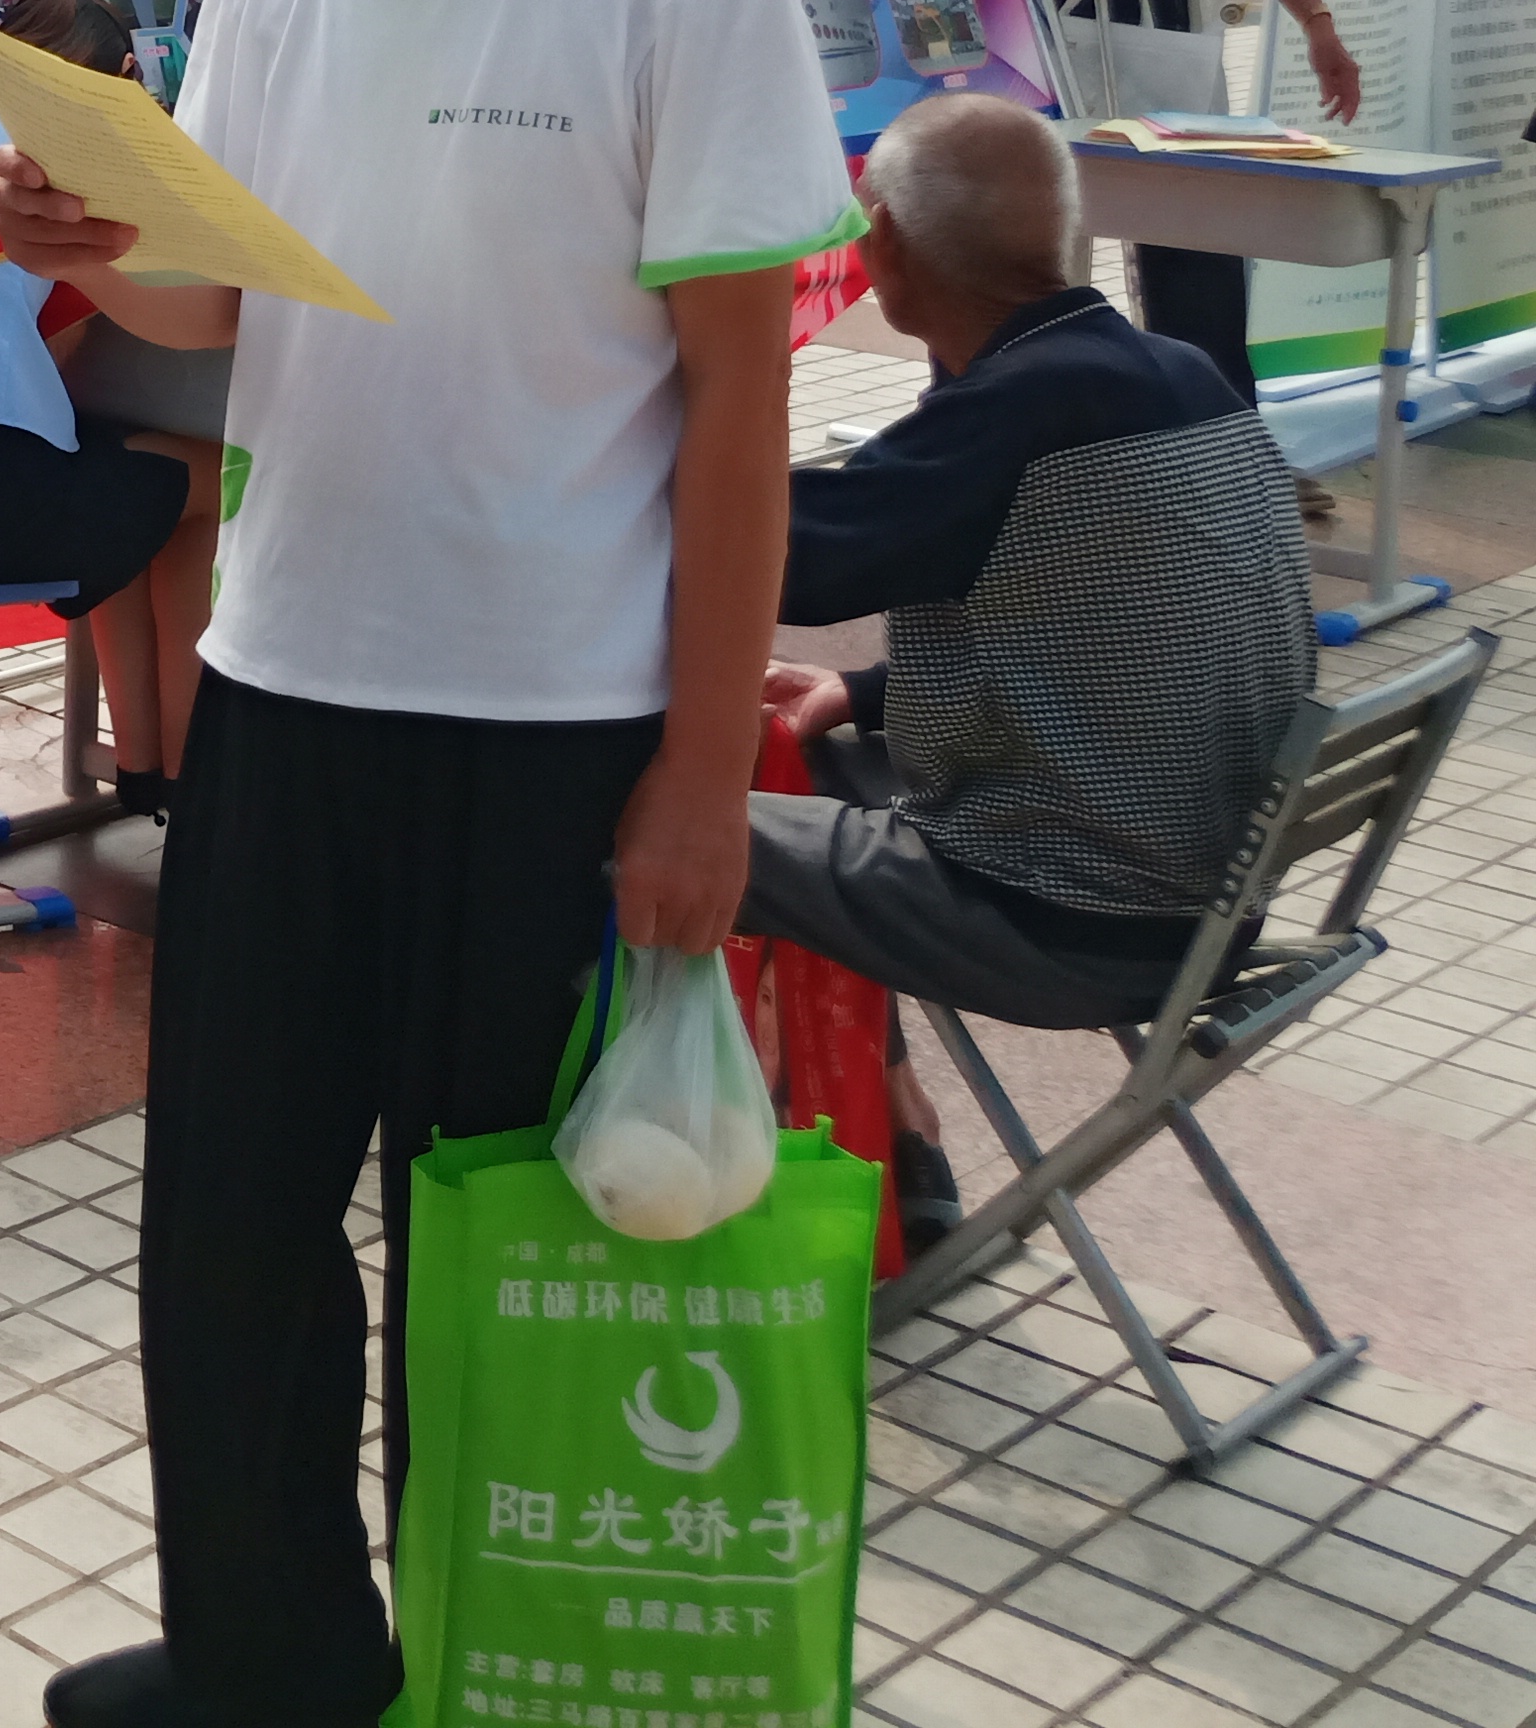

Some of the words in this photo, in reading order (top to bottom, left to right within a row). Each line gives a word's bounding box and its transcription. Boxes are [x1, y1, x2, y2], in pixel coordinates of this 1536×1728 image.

[440, 108, 573, 133] NUTRILITE
[498, 1278, 669, 1324] 低碳环保
[487, 1481, 810, 1564] 阳光娇子
